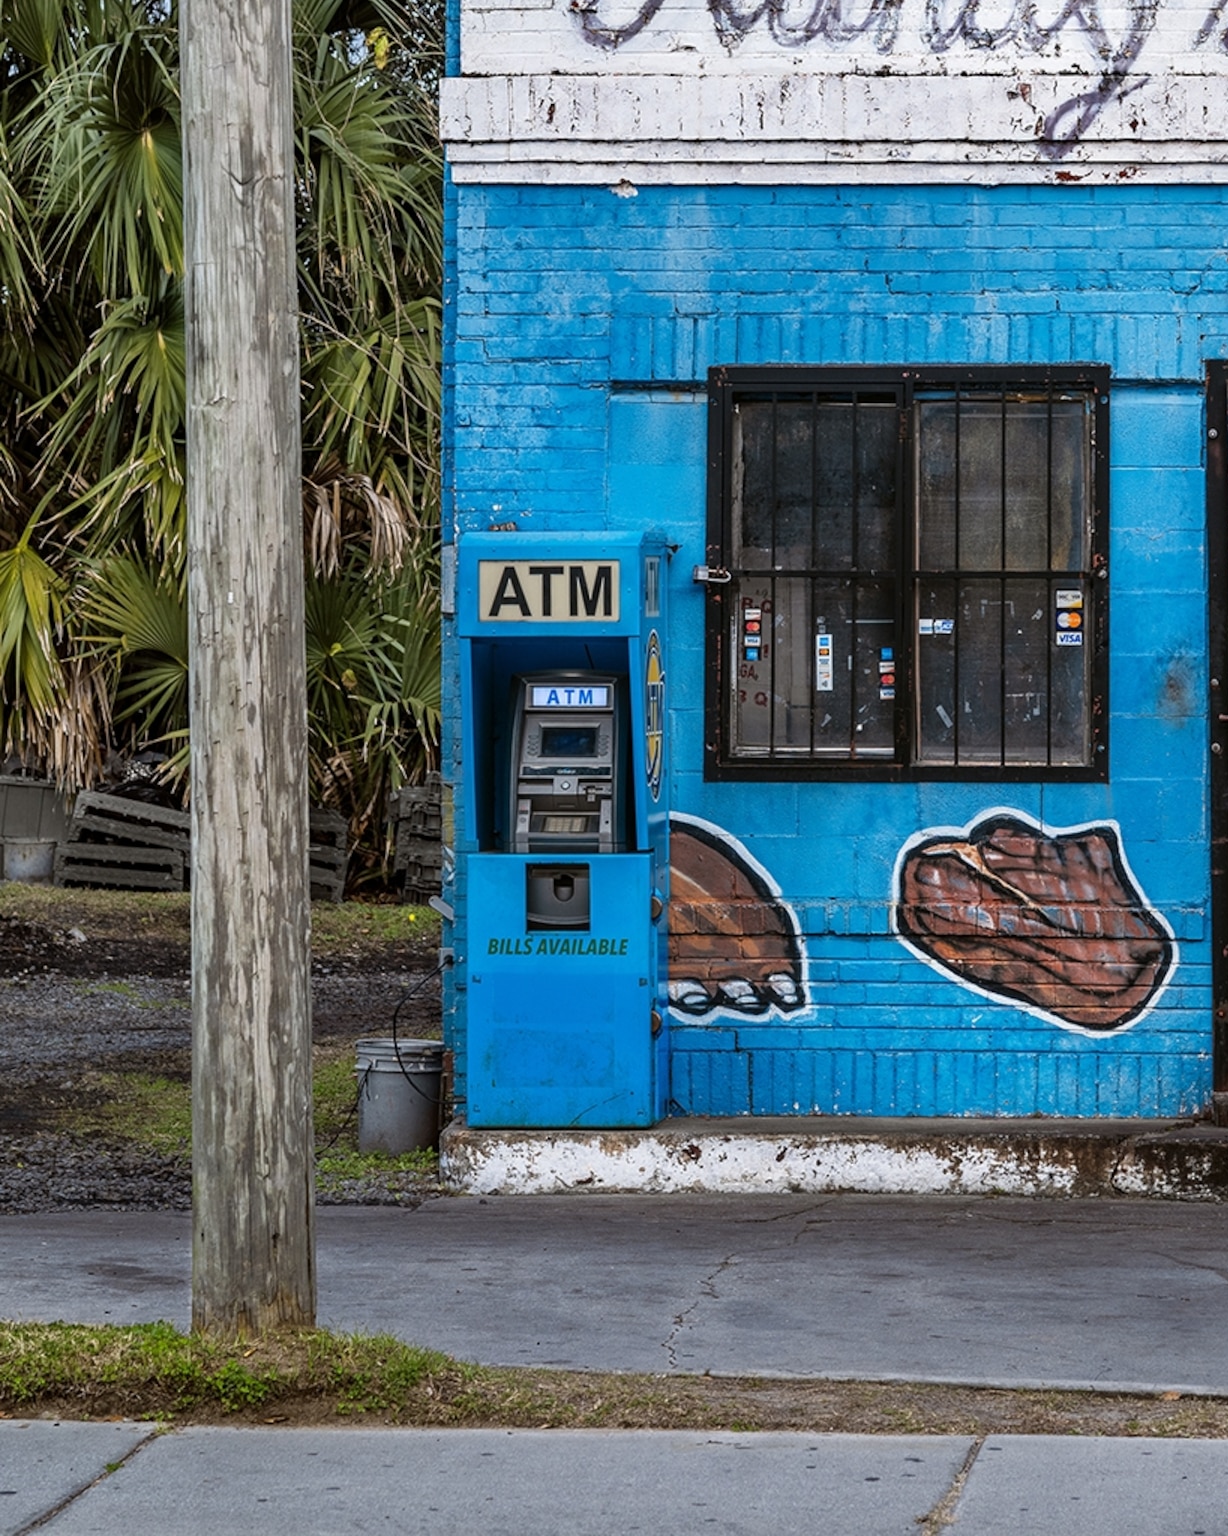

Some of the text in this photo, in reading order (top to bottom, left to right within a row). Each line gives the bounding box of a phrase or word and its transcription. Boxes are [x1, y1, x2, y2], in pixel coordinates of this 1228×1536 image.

[488, 566, 612, 617] ATM
[1059, 634, 1081, 643] VISA
[547, 689, 594, 705] ATM
[487, 937, 629, 956] BILLS AVAILABLE
